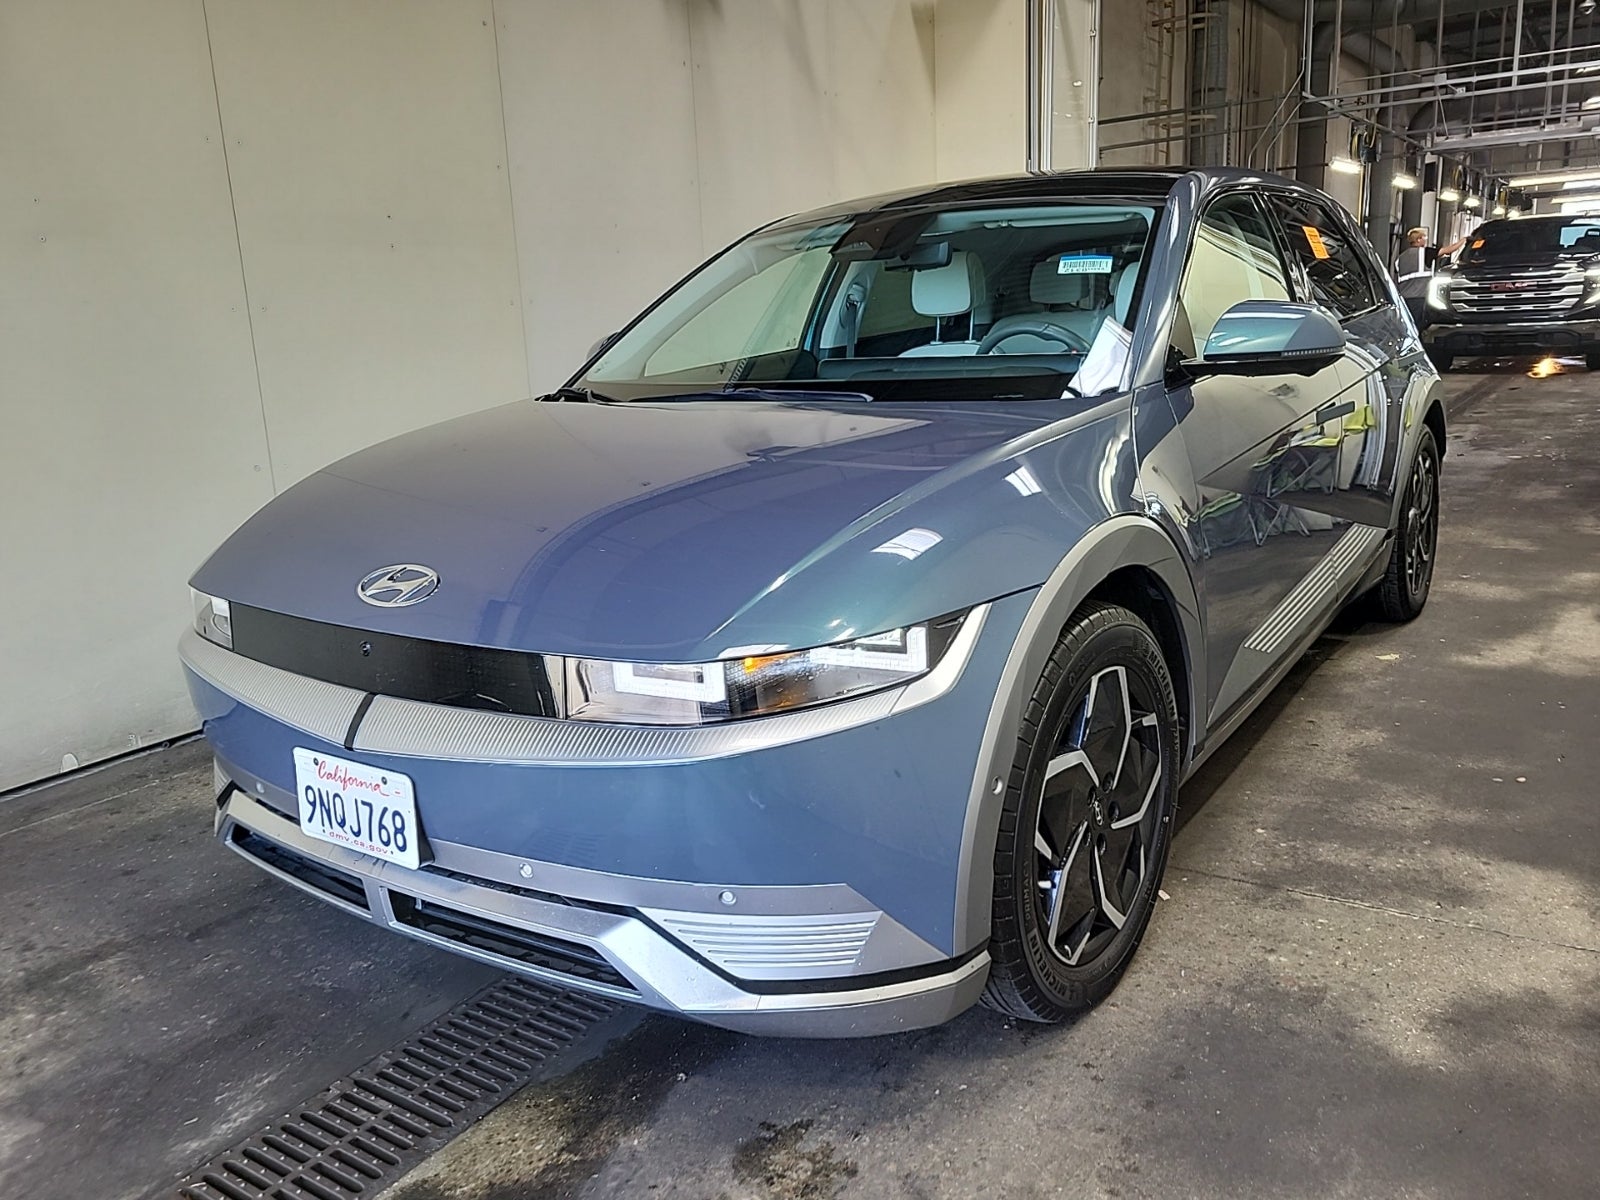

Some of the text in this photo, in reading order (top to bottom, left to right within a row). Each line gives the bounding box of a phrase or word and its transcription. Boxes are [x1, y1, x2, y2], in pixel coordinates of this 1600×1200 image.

[1148, 650, 1176, 717] MICHELIN
[318, 760, 390, 796] California
[304, 785, 407, 853] 9NQJ768
[329, 832, 388, 855] dmv.ca.gov
[1029, 935, 1066, 997] MICHELIN
